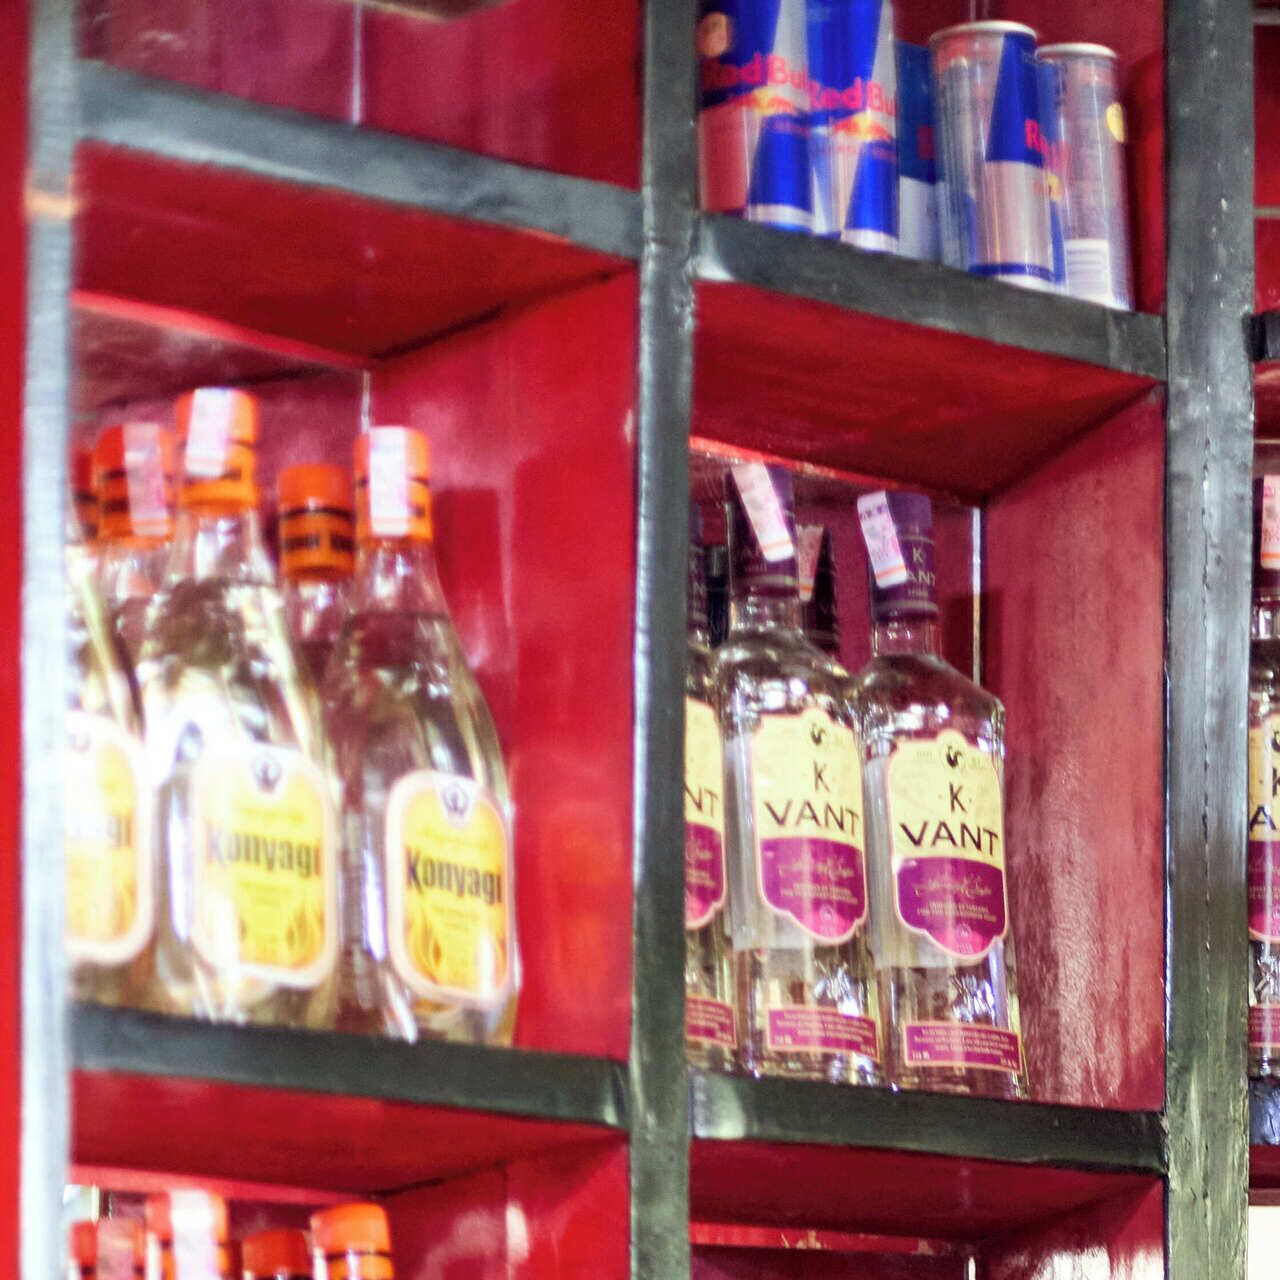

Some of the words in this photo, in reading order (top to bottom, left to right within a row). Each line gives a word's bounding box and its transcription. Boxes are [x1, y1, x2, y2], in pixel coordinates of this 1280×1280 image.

[813, 761, 830, 792] K
[685, 785, 719, 817] NT
[949, 783, 967, 814] K
[764, 799, 860, 838] VANT
[206, 833, 321, 878] Konyagi
[899, 820, 1000, 857] VANT
[405, 845, 502, 904] Konyagi
